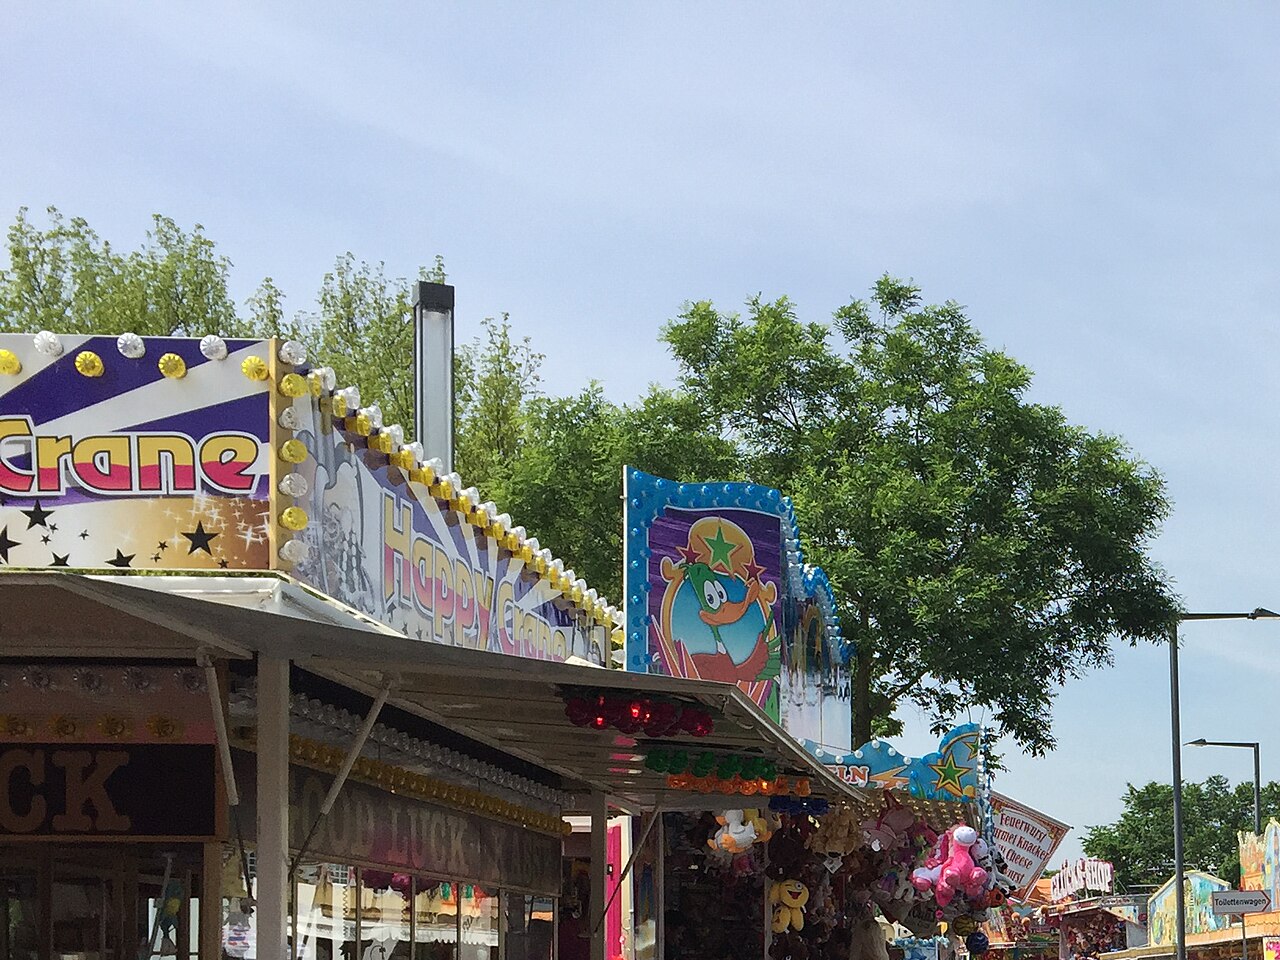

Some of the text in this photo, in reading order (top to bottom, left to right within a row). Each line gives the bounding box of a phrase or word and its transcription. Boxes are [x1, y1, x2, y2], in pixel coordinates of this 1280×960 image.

[0, 416, 260, 494] Crane
[383, 487, 495, 650] Happy
[1000, 812, 1048, 843] Feuerwurst
[1006, 848, 1034, 870] Cheese
[1016, 834, 1051, 861] Knacker
[1214, 898, 1267, 907] Toilettenwagen
